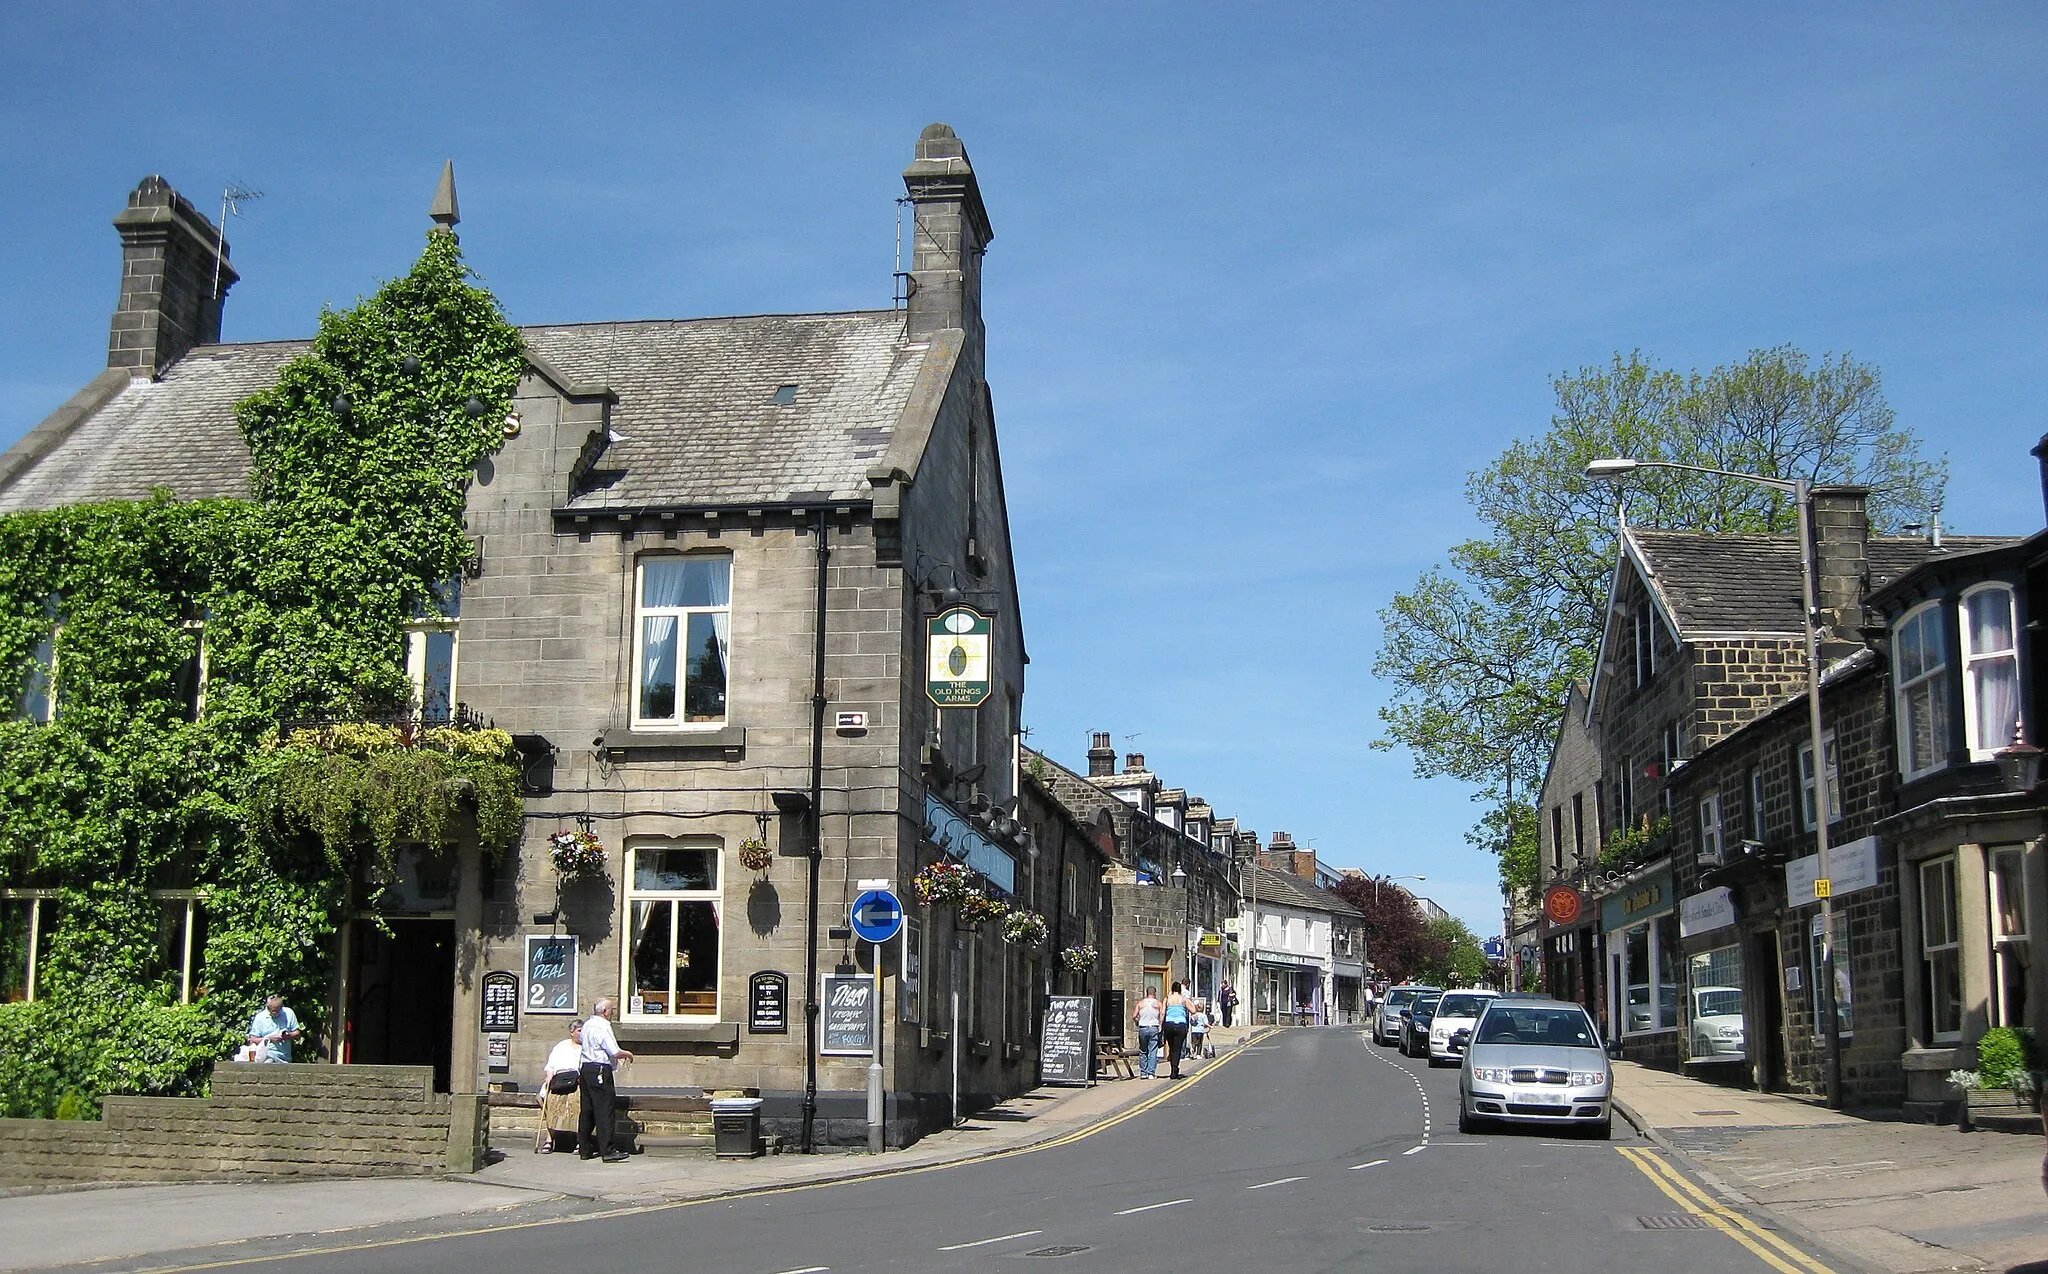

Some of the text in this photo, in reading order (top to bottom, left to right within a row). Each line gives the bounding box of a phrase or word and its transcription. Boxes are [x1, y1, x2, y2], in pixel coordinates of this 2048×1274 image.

[533, 945, 566, 962] MEAL
[533, 963, 566, 980] DEAL
[530, 983, 546, 1005] 2
[555, 992, 568, 1008] 6
[1050, 999, 1080, 1011] TWO FOR
